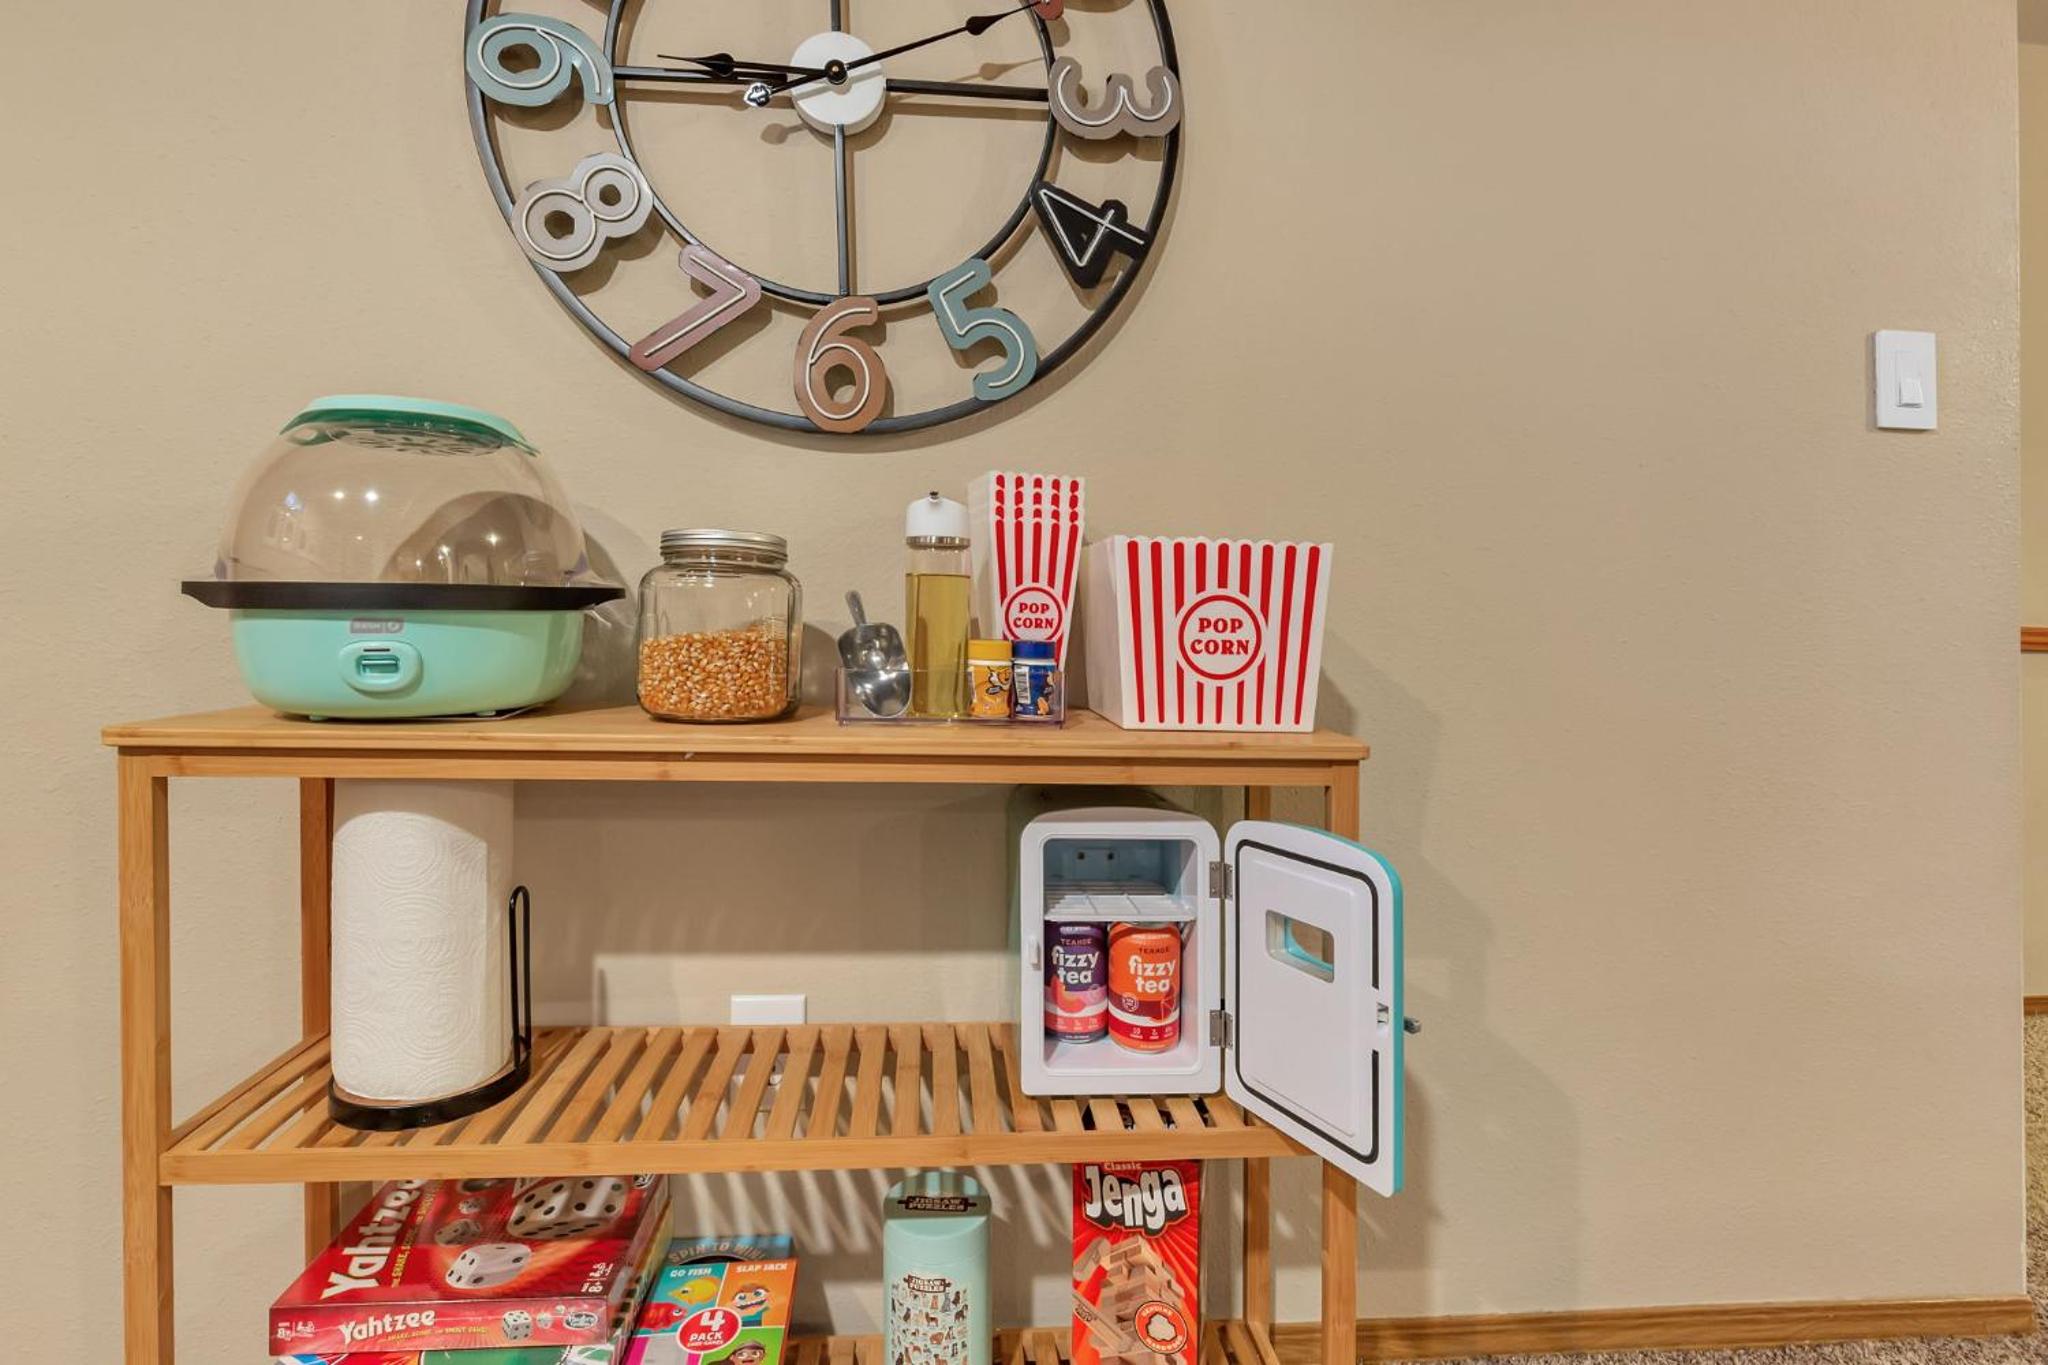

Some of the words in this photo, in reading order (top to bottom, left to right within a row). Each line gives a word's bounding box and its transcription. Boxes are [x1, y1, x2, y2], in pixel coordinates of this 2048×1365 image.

[1047, 56, 1182, 140] 3
[511, 153, 654, 272] 8
[1031, 181, 1148, 289] 4
[630, 244, 762, 371] 7
[928, 259, 1037, 400] 5
[794, 296, 887, 433] 6
[1018, 602, 1050, 614] POP
[1013, 616, 1054, 629] CORN
[1198, 617, 1244, 634] POP
[1190, 638, 1250, 656] CORN
[1051, 945, 1100, 968] fizzy
[1128, 955, 1176, 976] fizzy
[1057, 967, 1093, 984] tea
[1136, 976, 1171, 993] tea
[1103, 1161, 1142, 1170] Classic
[1085, 1165, 1187, 1230] Jenga
[668, 1244, 706, 1266] SPIN
[713, 1241, 730, 1251] TO
[687, 1267, 712, 1276] FISH
[736, 1265, 762, 1273] SLAP
[763, 1263, 788, 1271] JACK
[339, 1310, 436, 1345] Yahtzee
[700, 1311, 726, 1332] 4
[689, 1331, 724, 1342] PACK
